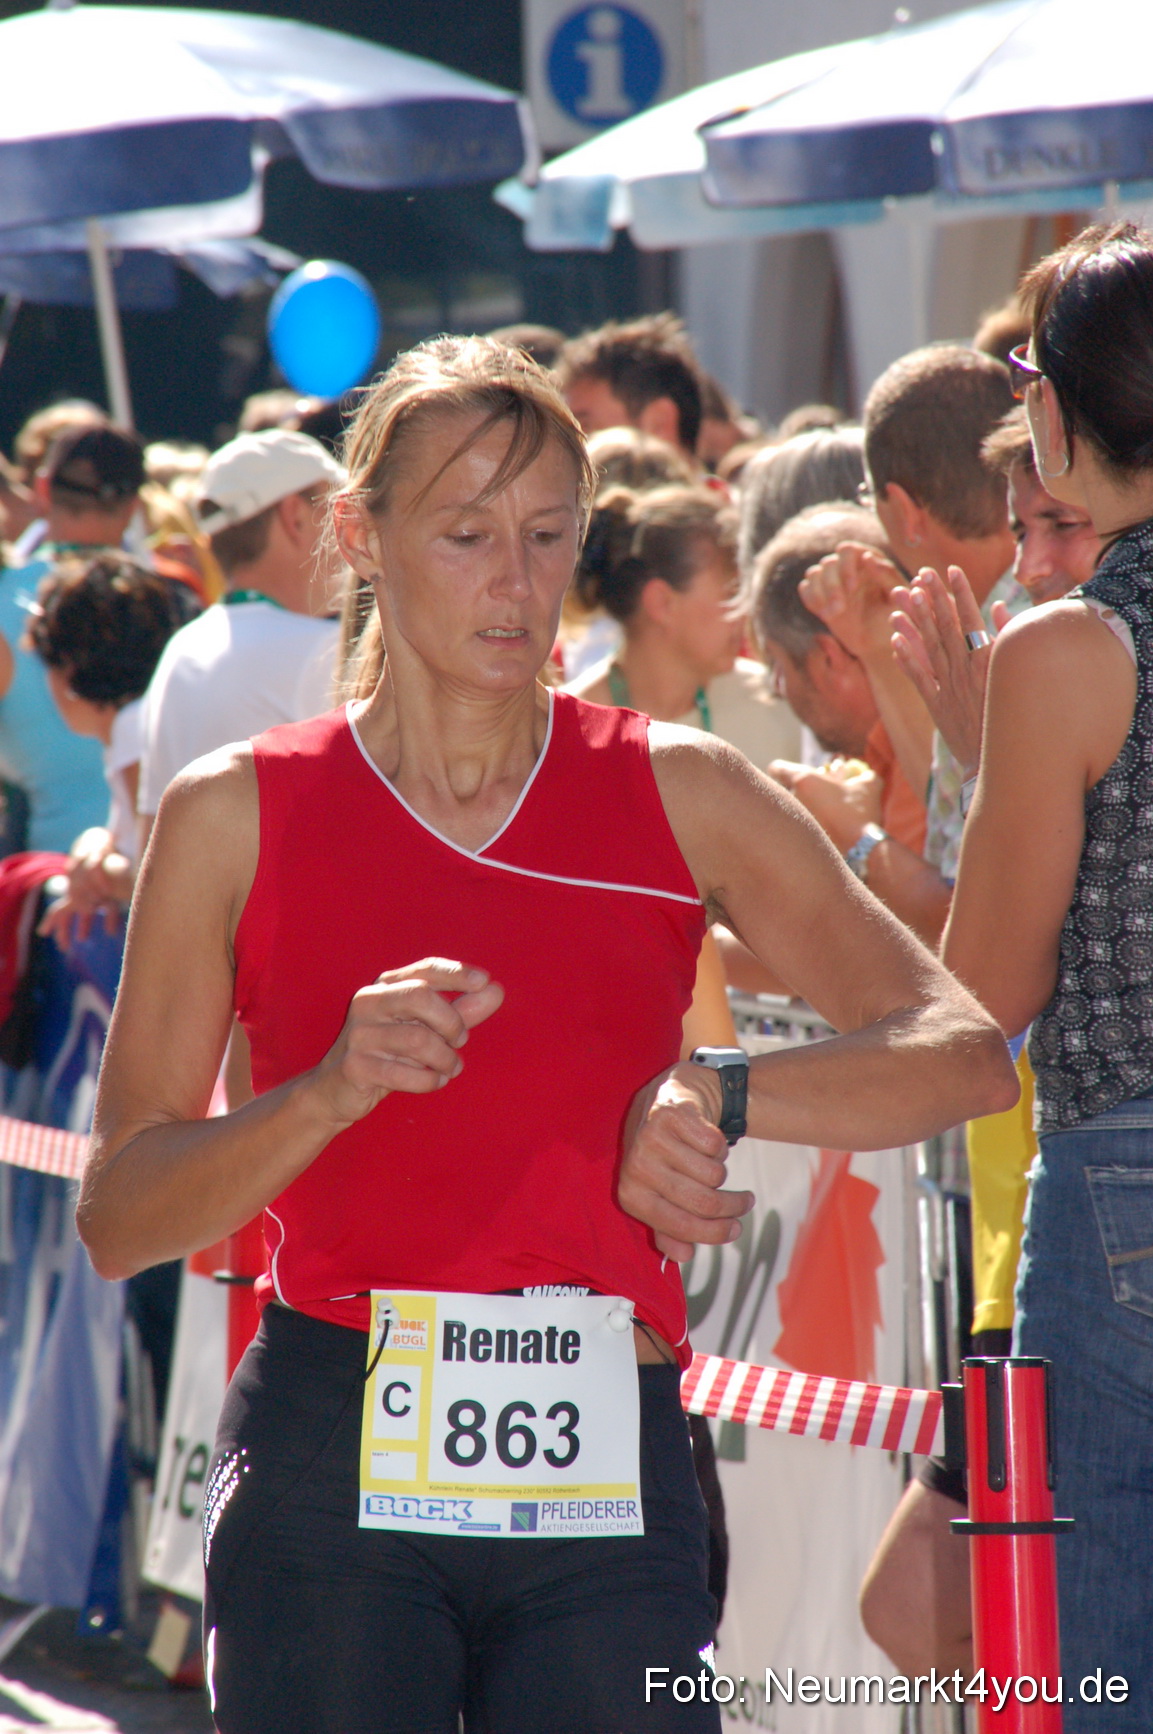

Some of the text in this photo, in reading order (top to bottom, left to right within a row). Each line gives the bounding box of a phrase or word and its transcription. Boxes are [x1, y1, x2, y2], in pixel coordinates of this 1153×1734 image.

[442, 1320, 581, 1364] Renate
[382, 1381, 412, 1418] C
[444, 1399, 580, 1469] 863
[365, 1495, 474, 1521] BOCK
[541, 1500, 638, 1520] PFLEIDERER
[540, 1522, 640, 1533] AKTIENGESELLSCHAFT
